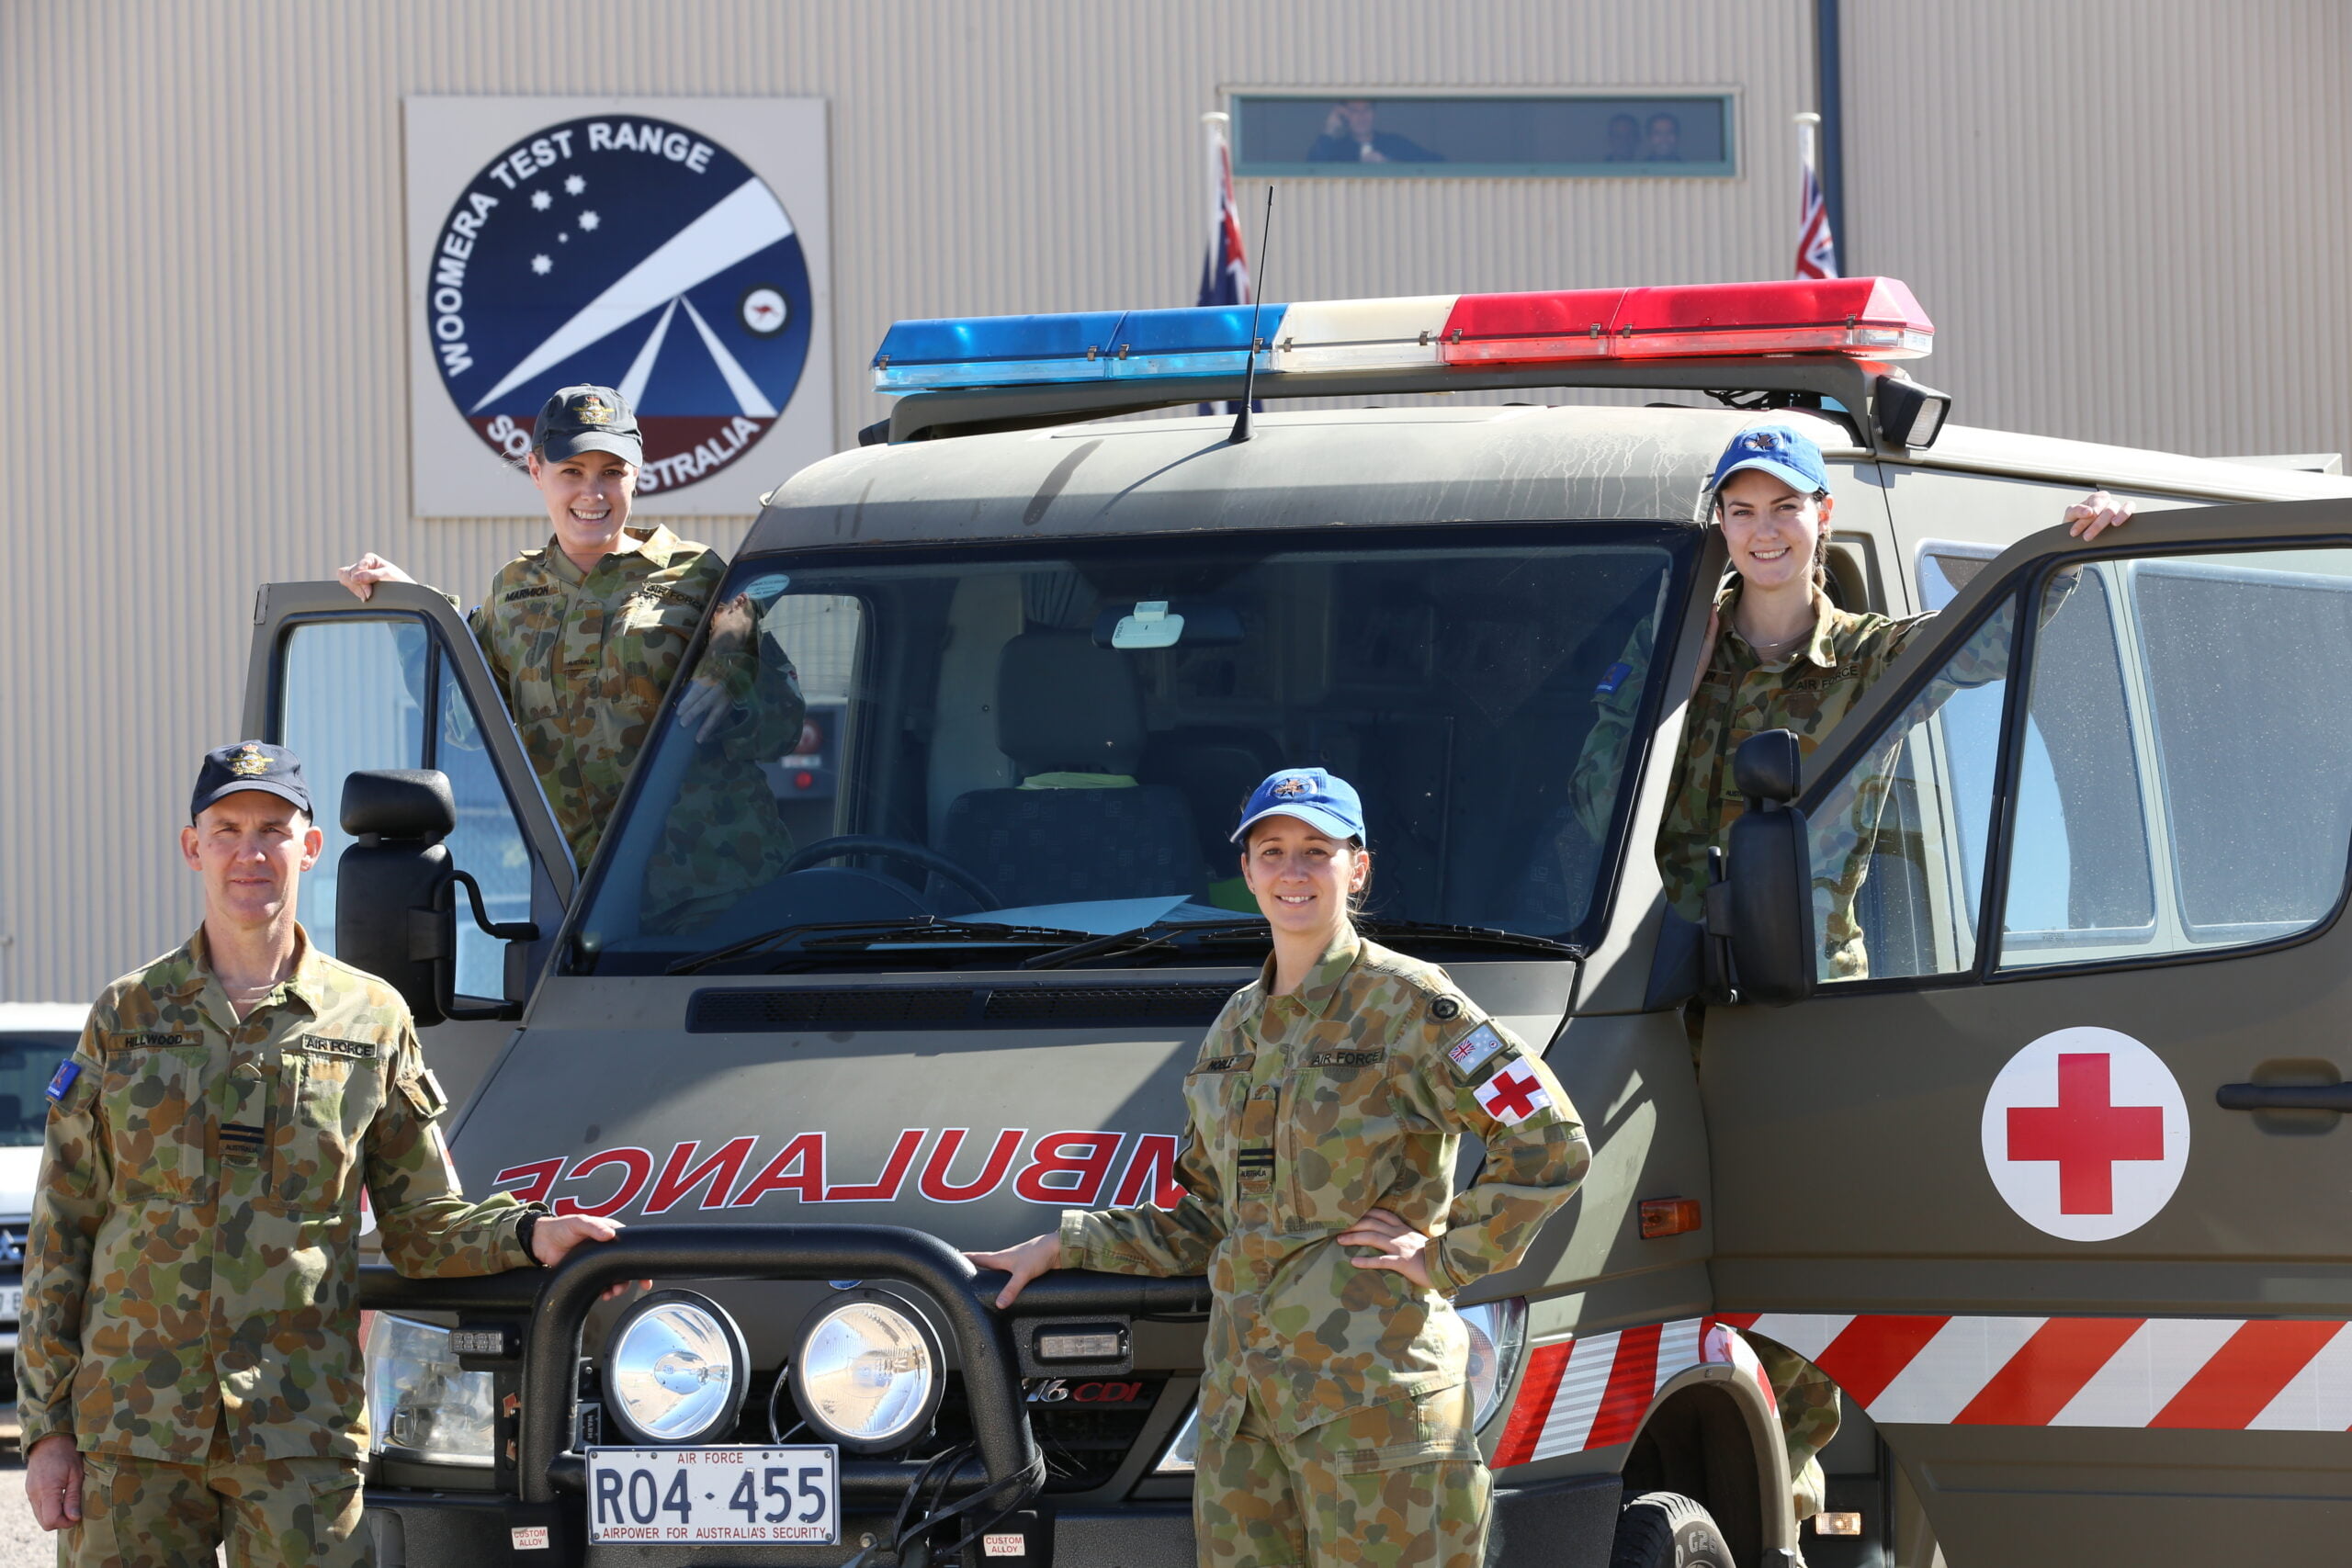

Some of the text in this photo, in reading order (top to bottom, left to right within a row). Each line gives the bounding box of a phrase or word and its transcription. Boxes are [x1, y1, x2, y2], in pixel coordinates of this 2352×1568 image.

[435, 122, 715, 378] WOOMERA TEST RANGE
[638, 415, 762, 492] STRALIA
[505, 585, 549, 602] MARMION
[1797, 665, 1860, 691] AIR FORCE
[125, 1034, 184, 1047] HILLWOOD
[306, 1037, 372, 1056] AIR FORCE
[1312, 1051, 1381, 1066] AIR FORCE
[1025, 1379, 1143, 1403] 16 CDI
[677, 1452, 743, 1464] AIR FORCE
[514, 1529, 547, 1539] CUSTOM
[603, 1527, 827, 1539] AIRPOWER FOR AUSTRALIA'S SECURITY
[519, 1538, 543, 1546] ALLOY
[991, 1545, 1018, 1553] ALLOY
